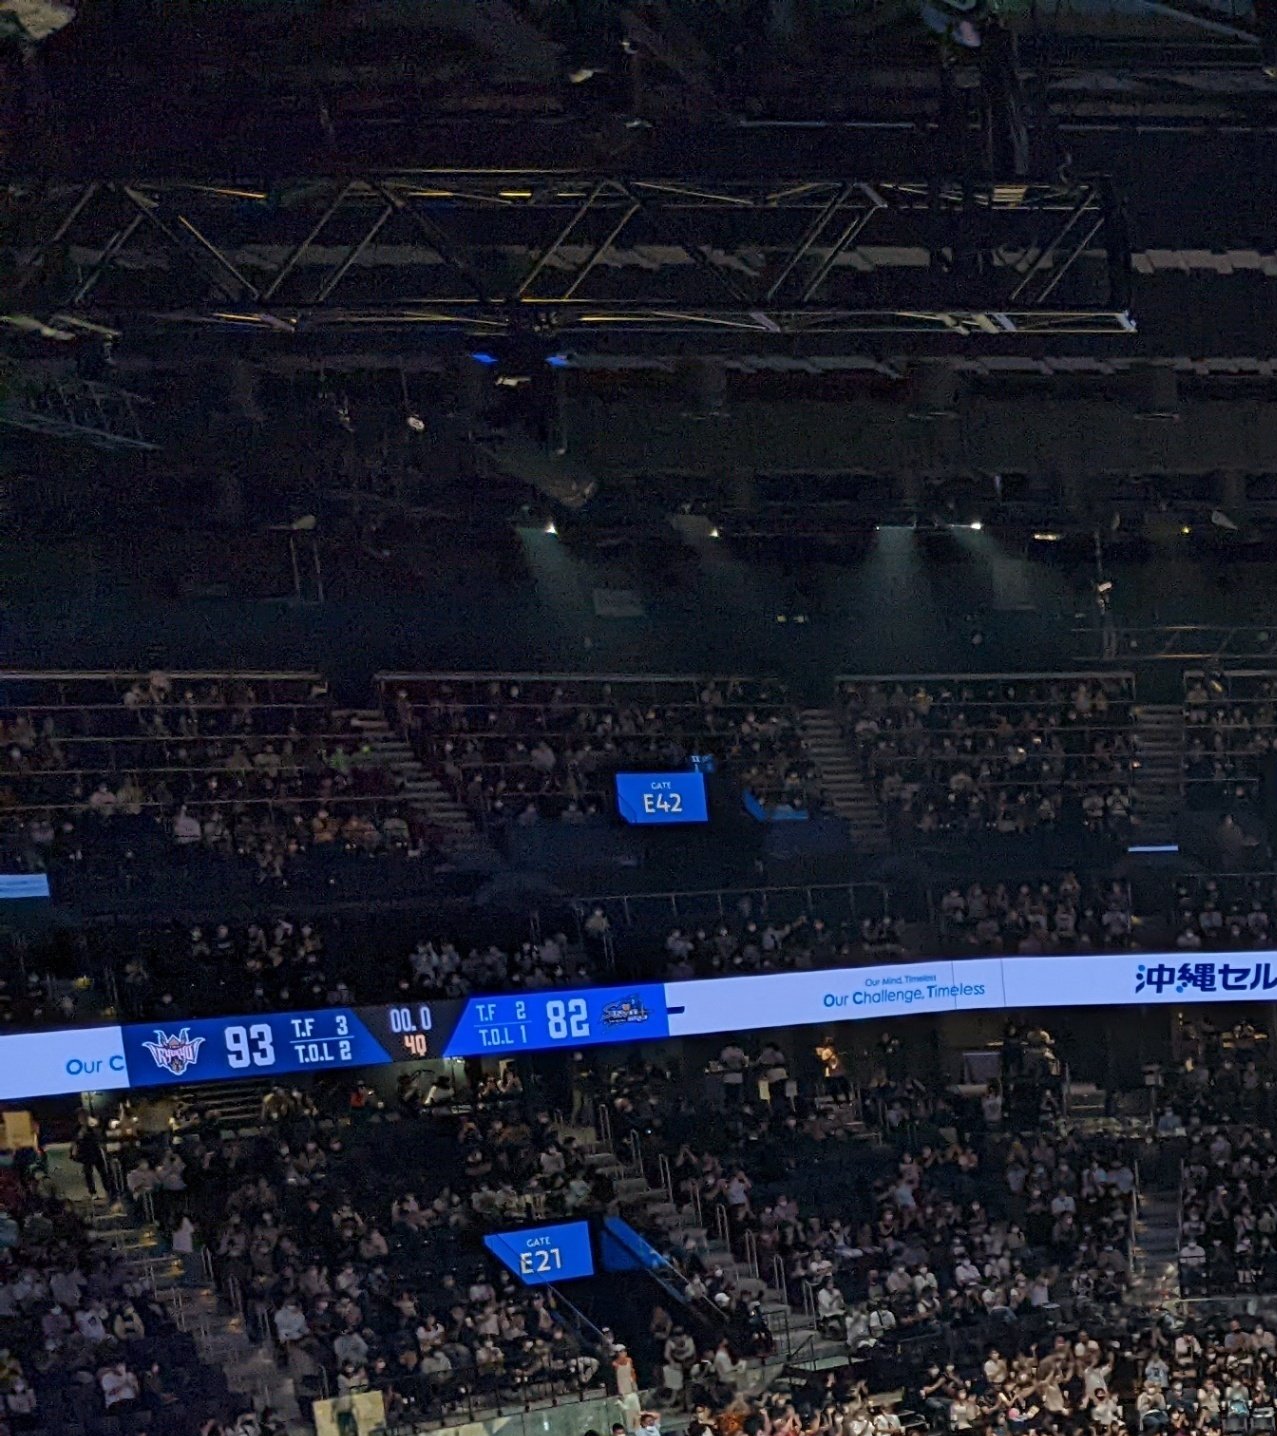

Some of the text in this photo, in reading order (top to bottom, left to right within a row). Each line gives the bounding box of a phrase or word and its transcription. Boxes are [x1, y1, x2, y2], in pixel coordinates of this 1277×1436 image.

[651, 782, 672, 790] GATE
[643, 793, 683, 813] E42
[824, 983, 985, 1008] Our Challenge, Timeless
[475, 1001, 526, 1022] T.F 2
[546, 998, 590, 1039] 82
[291, 1015, 349, 1038] T.F 3
[479, 1024, 528, 1047] T.O.L 1
[224, 1024, 276, 1069] 93
[295, 1040, 352, 1063] T.O.L 2
[404, 1034, 427, 1057] 4Q
[66, 1058, 102, 1076] Our
[526, 1236, 551, 1248] GATE
[520, 1248, 562, 1274] E21
